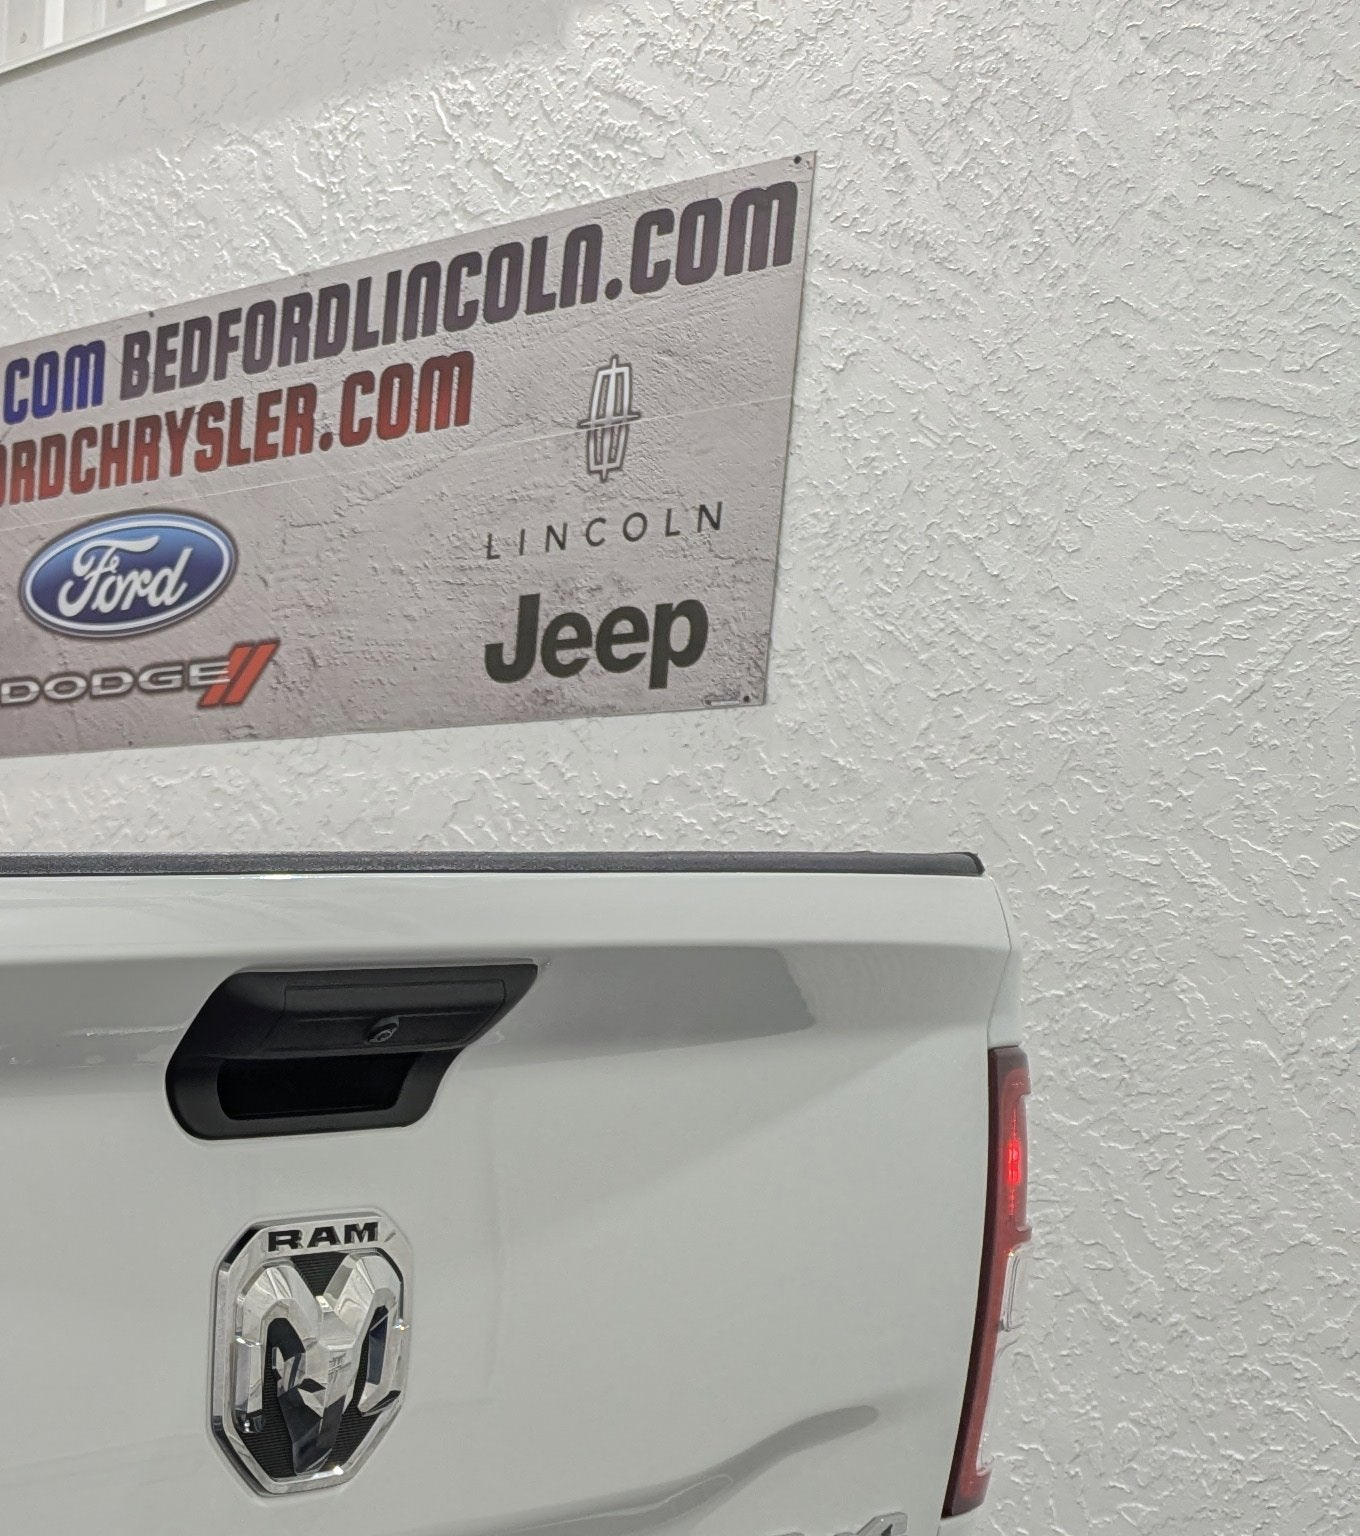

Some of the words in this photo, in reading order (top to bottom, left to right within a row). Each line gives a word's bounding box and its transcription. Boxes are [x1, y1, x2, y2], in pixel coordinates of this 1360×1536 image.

[120, 181, 798, 400] BEDFORDLINCOLN.COM
[485, 501, 723, 560] LINCOLN
[57, 535, 194, 617] Ford
[484, 593, 709, 690] Jeep
[0, 656, 230, 707] DODGE
[267, 1221, 379, 1252] RAM
